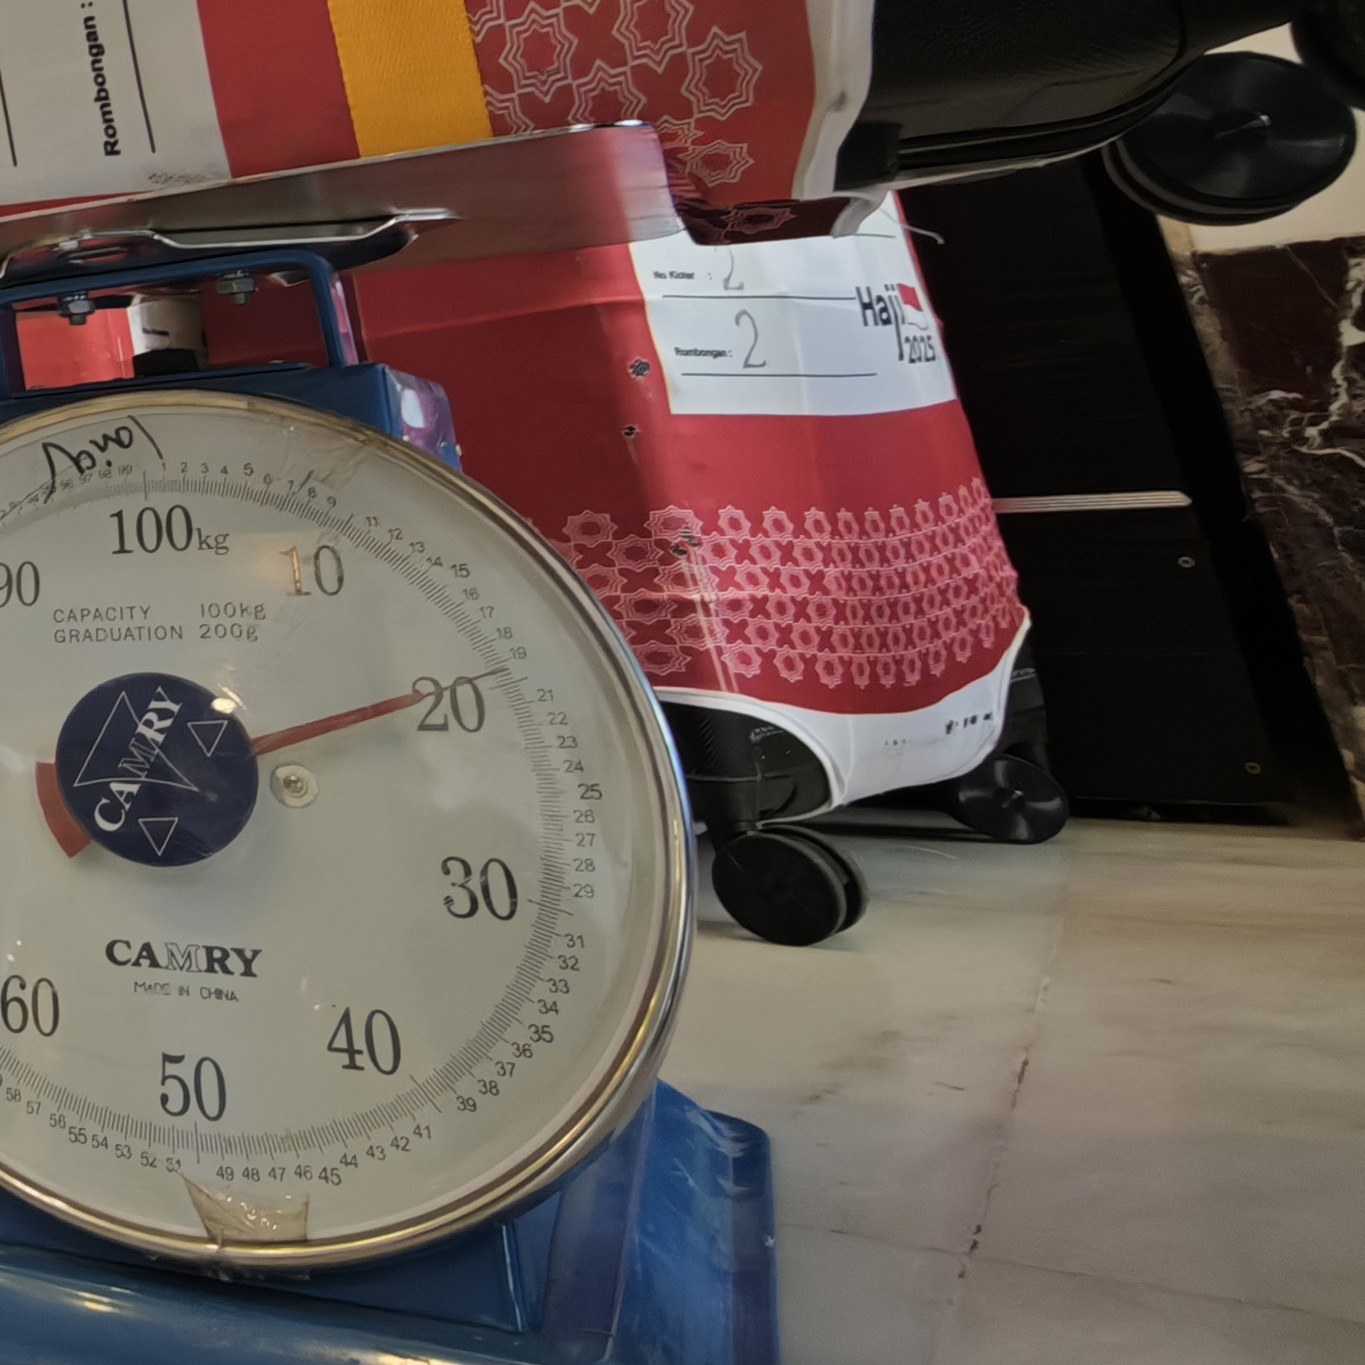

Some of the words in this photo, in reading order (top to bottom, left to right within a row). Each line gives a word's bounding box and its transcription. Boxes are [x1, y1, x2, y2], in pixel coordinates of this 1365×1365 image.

[82, 15, 122, 158] Rombongan
[735, 309, 767, 369] 2
[904, 335, 937, 364] 2025
[180, 461, 188, 474] 2
[201, 462, 210, 474] 3
[221, 465, 229, 476] 4
[243, 463, 254, 476] 5
[388, 528, 403, 541] 12
[279, 545, 345, 596] 10
[450, 563, 471, 579] 15
[53, 605, 152, 624] CAPACITY
[480, 605, 495, 619] 17
[53, 624, 184, 644] GRADUATION
[537, 689, 554, 702] 21
[412, 676, 486, 733] 20
[547, 712, 569, 726] 22
[557, 736, 578, 749] 23
[94, 686, 183, 832] CAMRY
[563, 760, 584, 773] 24
[578, 784, 603, 800] 25
[573, 810, 595, 823] 26
[575, 833, 596, 847] 27
[573, 859, 596, 872] 28
[441, 856, 519, 922] 30
[573, 885, 595, 898] 29
[564, 933, 585, 949] 31
[105, 939, 263, 978] CAMRY
[557, 955, 580, 971] 32
[548, 979, 570, 994] 33
[0, 974, 60, 1037] 60
[537, 999, 560, 1015] 34
[326, 1006, 402, 1076] 40
[528, 1024, 554, 1044] 35
[511, 1043, 533, 1059] 36
[495, 1062, 516, 1078] 37
[160, 1051, 227, 1122] 50
[478, 1080, 500, 1096] 38
[5, 1087, 22, 1103] 58
[26, 1101, 41, 1115] 57
[456, 1096, 477, 1113] 39
[49, 1113, 66, 1130] 56
[68, 1127, 88, 1144] 55
[413, 1124, 432, 1140] 41
[91, 1135, 109, 1150] 54
[390, 1135, 411, 1152] 42
[115, 1143, 132, 1159] 53
[366, 1145, 387, 1161] 43
[140, 1151, 158, 1169] 52
[339, 1153, 359, 1169] 44
[215, 1166, 235, 1182] 49
[242, 1166, 261, 1183] 48
[268, 1166, 286, 1182] 47
[294, 1164, 314, 1181] 46
[318, 1167, 342, 1186] 45
